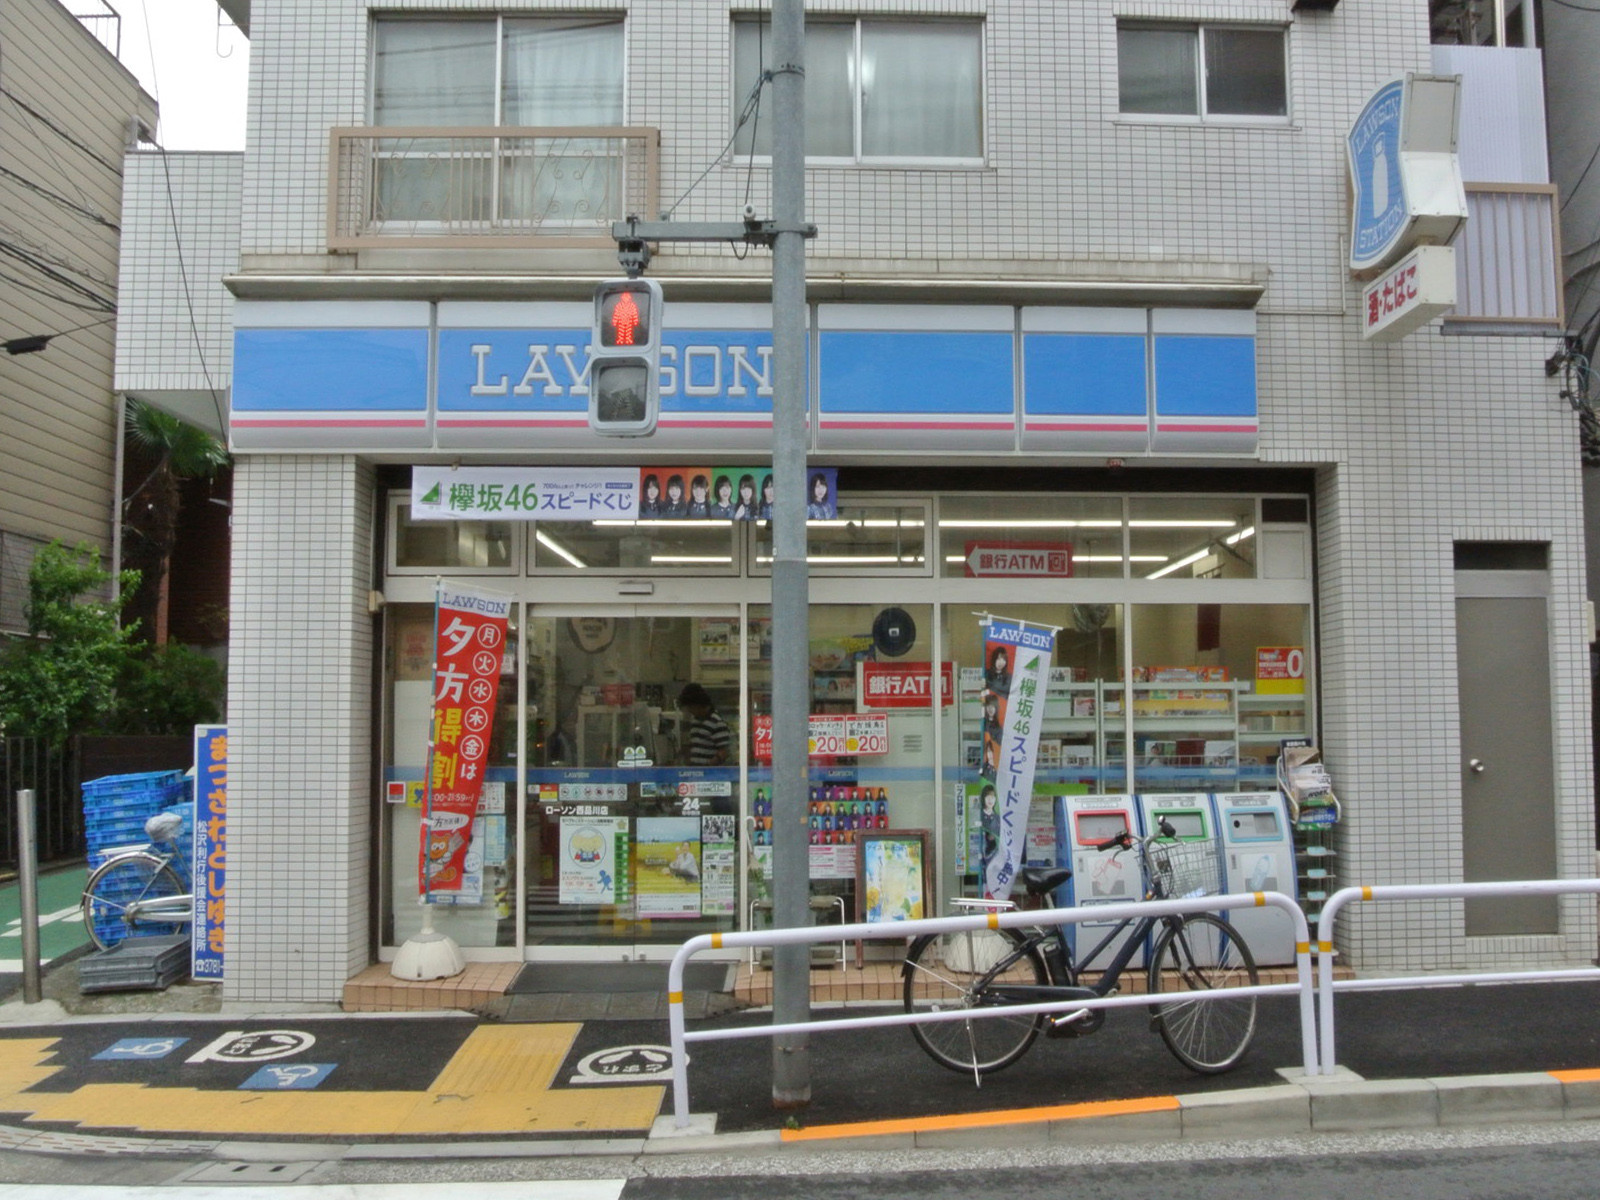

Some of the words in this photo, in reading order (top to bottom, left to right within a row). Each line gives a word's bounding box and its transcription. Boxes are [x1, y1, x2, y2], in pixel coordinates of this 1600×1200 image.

[1356, 97, 1399, 153] LAWSON
[1359, 198, 1402, 249] STATION
[449, 482, 539, 511] 欅坂46
[541, 492, 632, 511] スピードくじ
[980, 553, 1044, 570] 銀行ATM
[443, 592, 507, 614] LAWSON
[990, 626, 1052, 649] LAWSON
[682, 798, 700, 812] 24
